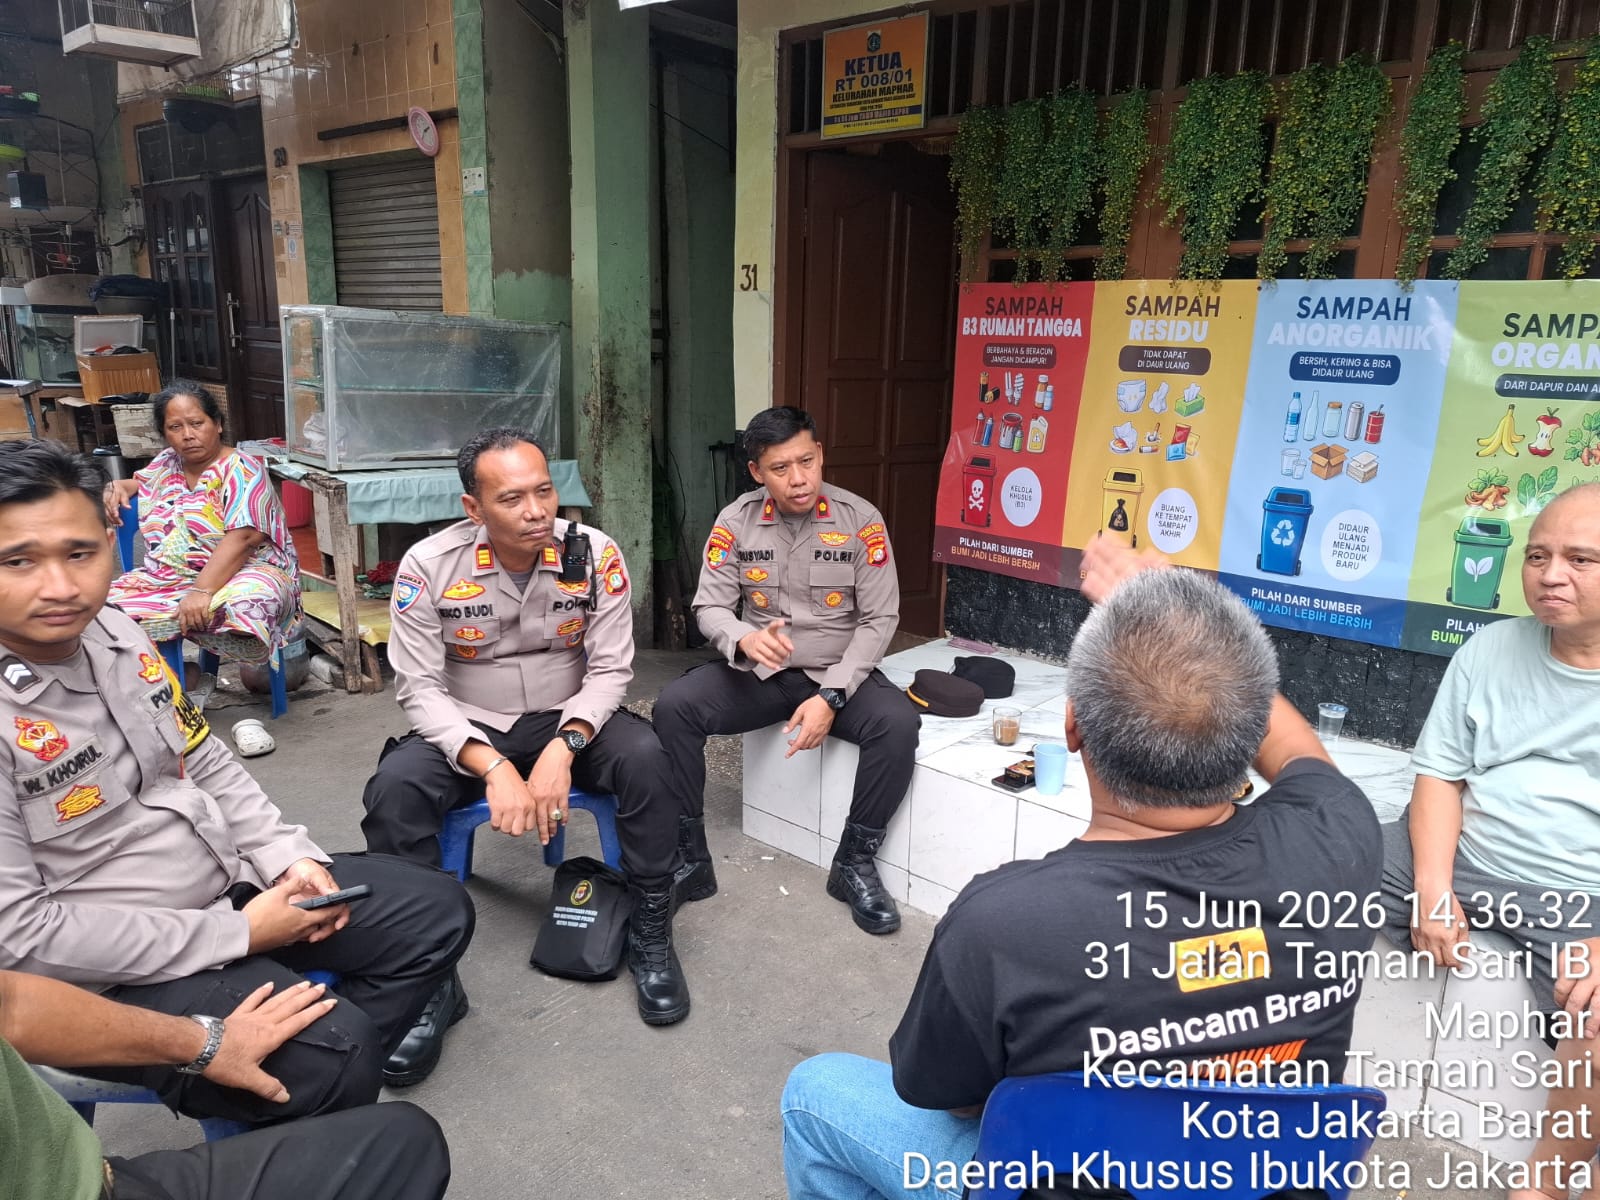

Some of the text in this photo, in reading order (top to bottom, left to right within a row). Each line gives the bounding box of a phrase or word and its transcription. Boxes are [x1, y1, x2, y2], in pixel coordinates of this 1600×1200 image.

[845, 52, 901, 76] KETUA
[836, 68, 912, 92] RT 008/01
[833, 88, 877, 103] KELURAHAN
[879, 83, 914, 97] MAPHAR
[740, 263, 758, 291] 31
[985, 296, 1063, 316] SAMPAH
[1125, 295, 1221, 317] SAMPAH
[1296, 296, 1412, 321] SAMPAH
[962, 317, 1082, 337] B3 RUMAH TANGGA
[1128, 319, 1209, 343] RESIDU
[1502, 312, 1600, 339] SAMP
[1266, 321, 1434, 351] ANORGANIK
[986, 346, 1019, 355] BERBAHAYA
[1026, 347, 1053, 356] BERACUN
[1143, 350, 1188, 360] TIDAK DAPAT
[991, 355, 1014, 364] JANGAN
[1137, 360, 1190, 370] DI DAUR ULANG
[1299, 356, 1392, 369] BERSIH, KERING & BISA
[1312, 367, 1375, 379] DIDAUR ULANG
[1503, 380, 1527, 390] DARI
[1529, 381, 1564, 392] DAPUR
[1566, 382, 1588, 393] DAN
[1010, 485, 1033, 494] KELOLA
[1161, 503, 1186, 514] BUANG
[1155, 511, 1192, 523] KE TEMPAT
[1158, 520, 1187, 531] SAMPAH
[1338, 522, 1369, 534] DIDAUR
[1160, 529, 1181, 538] AKHIR
[1338, 532, 1367, 543] ULANG
[959, 536, 1034, 559] PILAH DARI SUMBER
[1332, 540, 1370, 553] MENJADI
[814, 549, 853, 562] POLRI
[951, 546, 1040, 570] BUMI JADI LEBIH BERSIH
[1332, 550, 1368, 562] PRODUK
[1335, 560, 1360, 570] BARU
[1251, 587, 1362, 615] PILAH DARI SUMBER
[464, 603, 493, 618] BUDI
[1267, 604, 1291, 616] JADI
[1294, 608, 1327, 622] LEBIH
[1329, 613, 1373, 630] BERSIH
[1431, 629, 1464, 645] BUMI
[46, 745, 102, 787] KHOIRUL
[1089, 968, 1357, 1057] Dashcam Brand
